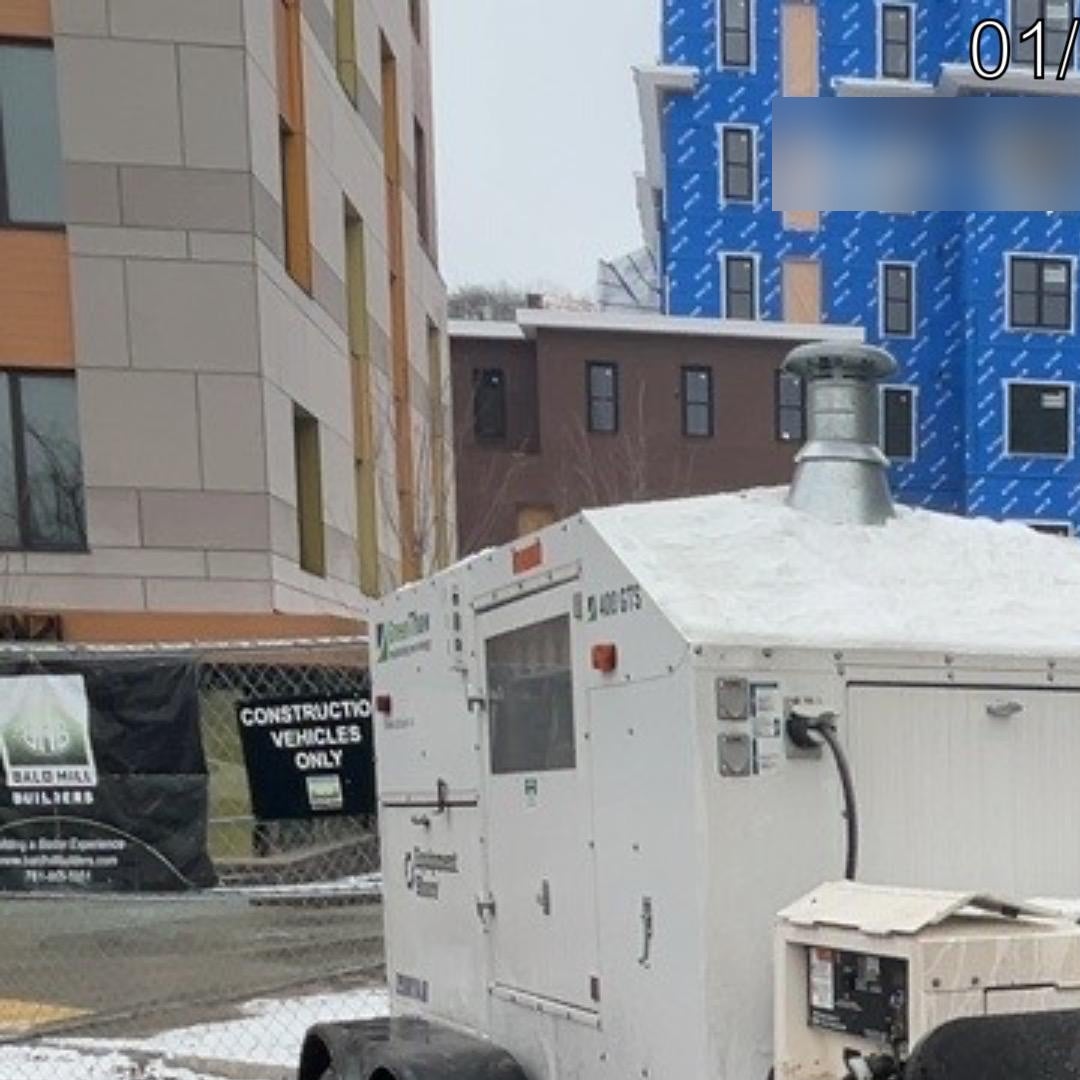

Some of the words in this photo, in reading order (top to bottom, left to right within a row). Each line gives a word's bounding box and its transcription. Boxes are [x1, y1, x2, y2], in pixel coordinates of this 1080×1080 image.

[240, 698, 372, 727] CONSTRUCTIO
[269, 724, 362, 748] VEHICLES
[295, 748, 343, 769] ONLY
